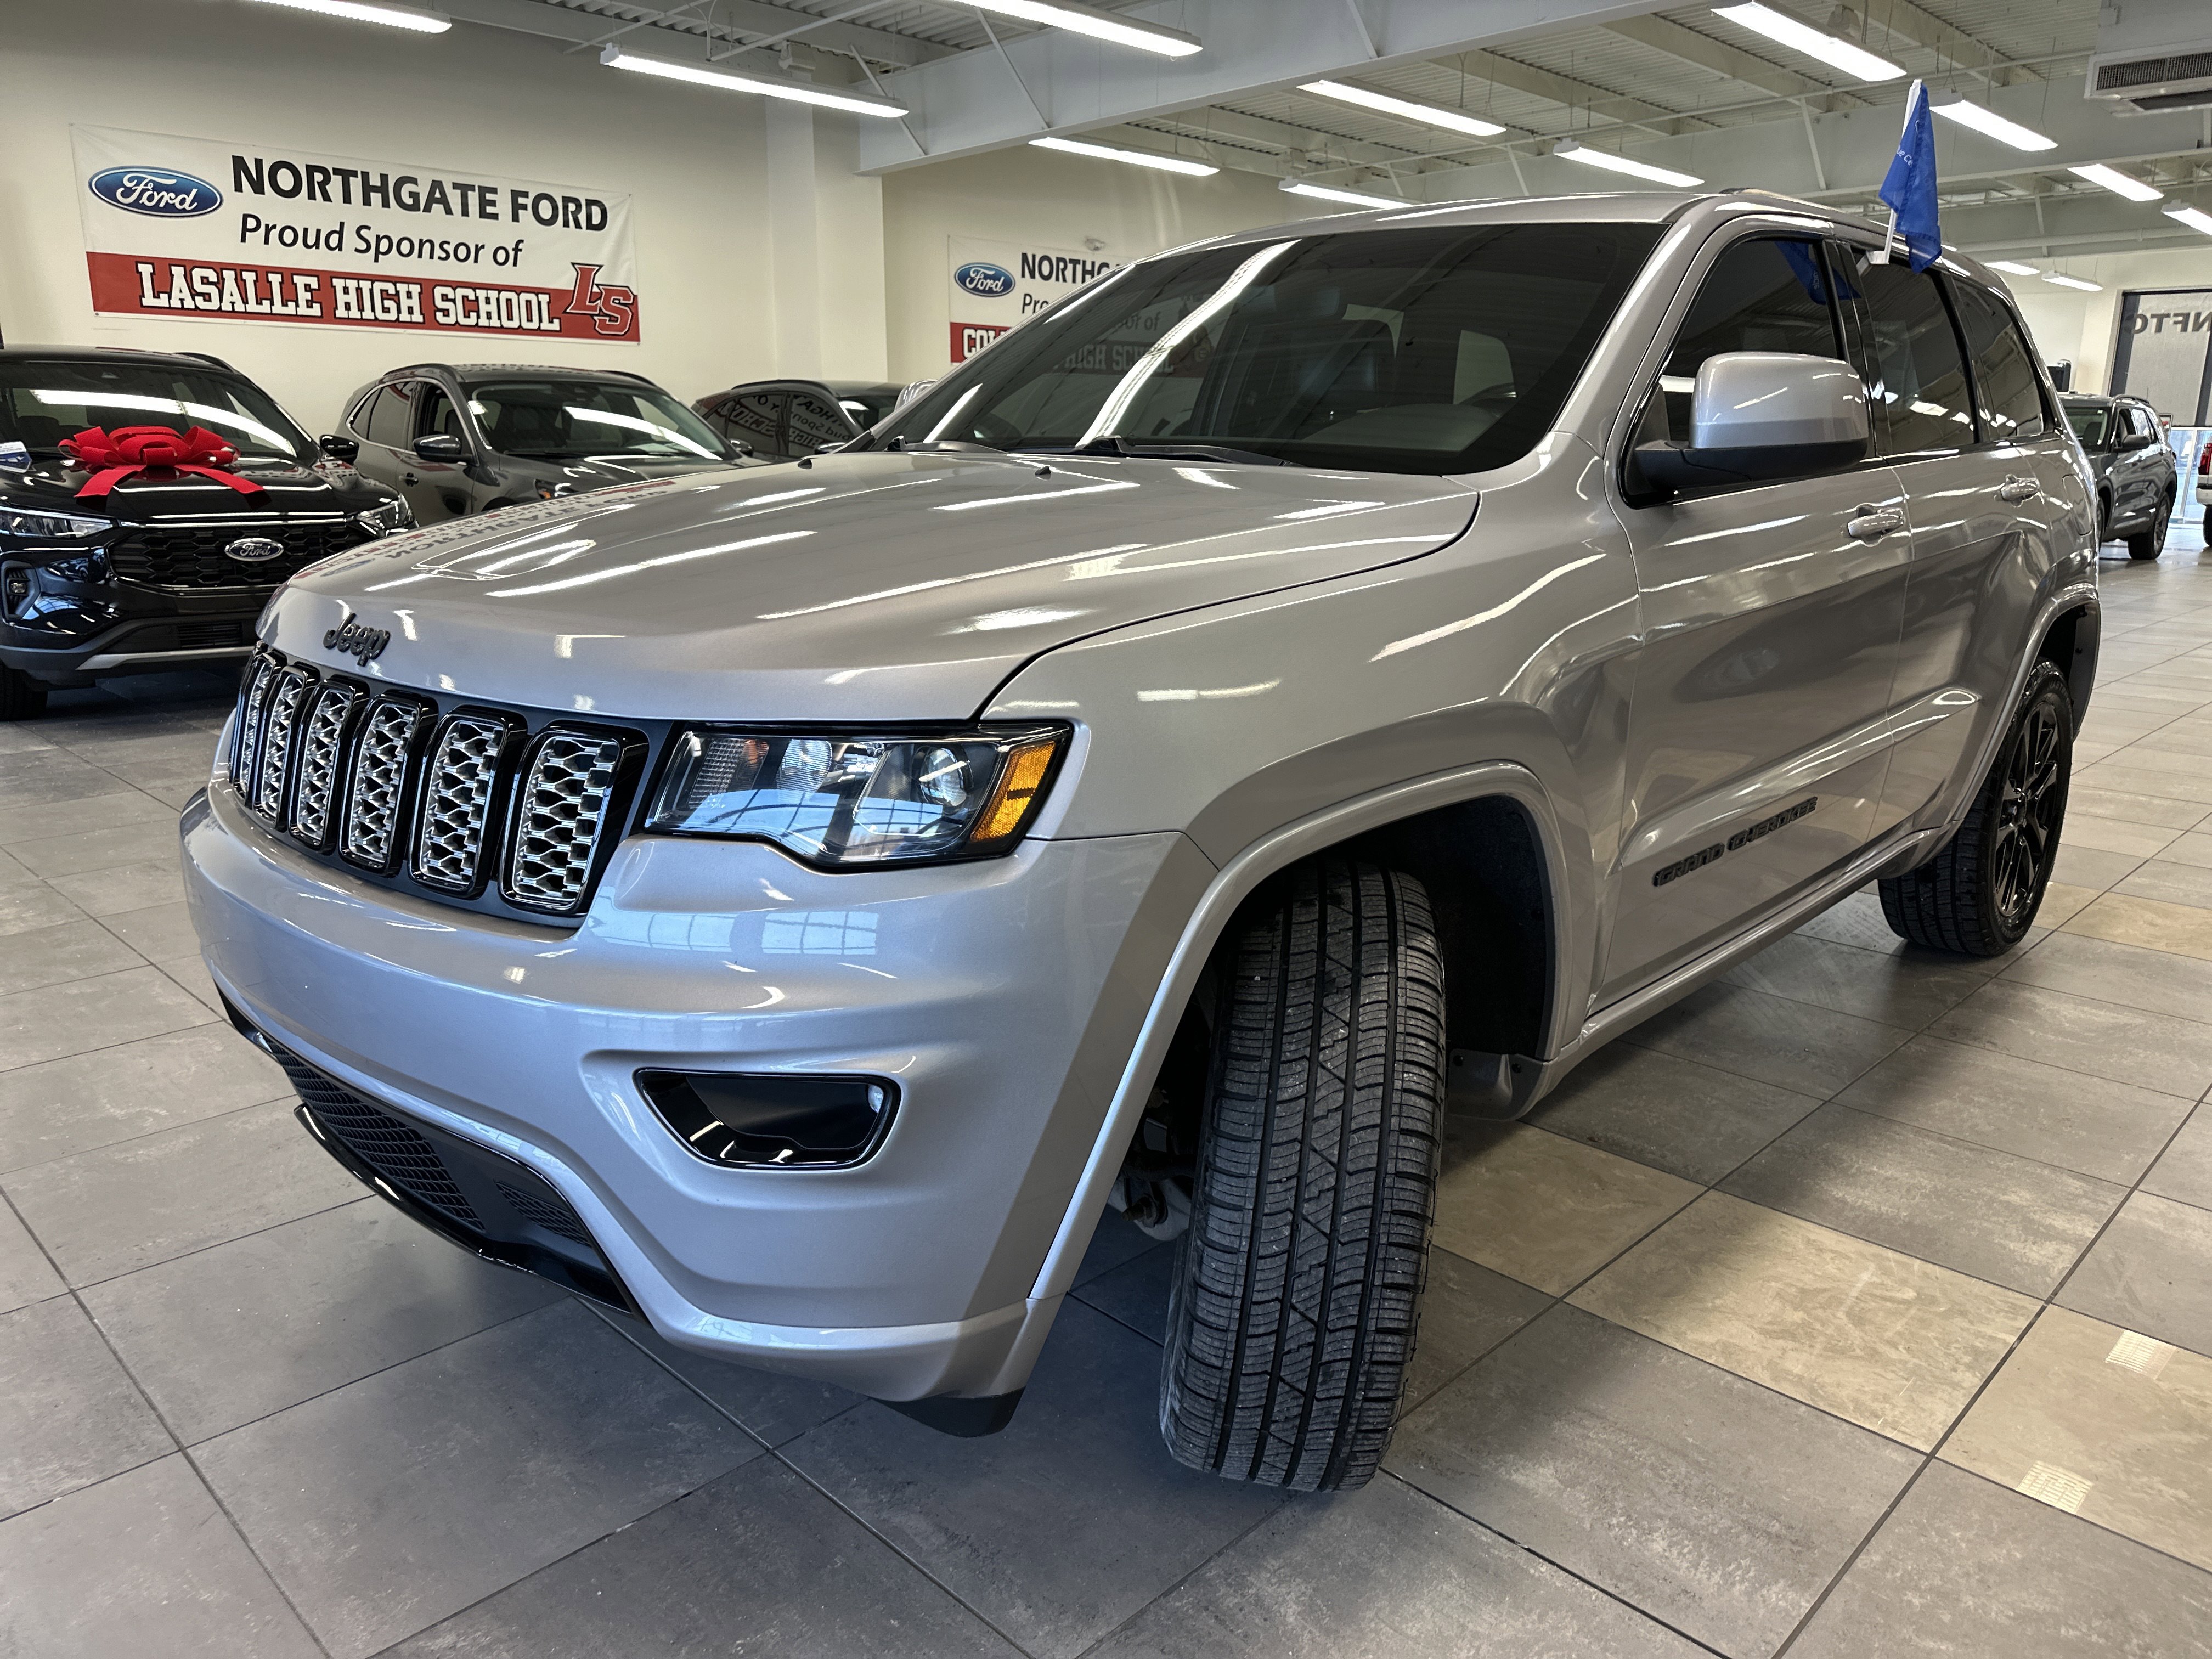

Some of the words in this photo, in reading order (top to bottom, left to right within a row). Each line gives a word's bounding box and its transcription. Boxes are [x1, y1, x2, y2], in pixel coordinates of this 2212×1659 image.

[116, 172, 198, 212] Ford
[232, 155, 499, 221] NORTHGATE
[511, 189, 607, 232] FORD
[240, 213, 345, 252] Proud
[354, 224, 485, 264] Sponsor
[492, 239, 524, 267] of
[137, 262, 321, 318] LASALLE
[332, 278, 424, 325] HIGH
[433, 286, 560, 332] SCHOOL
[566, 262, 635, 336] LS
[966, 267, 1003, 292] Ford
[1112, 345, 1174, 373] SCHL
[239, 542, 272, 556] Ford
[323, 613, 391, 667] Jeep
[1652, 842, 1725, 887] GRAND
[1727, 796, 1818, 851] CHEROKEE
